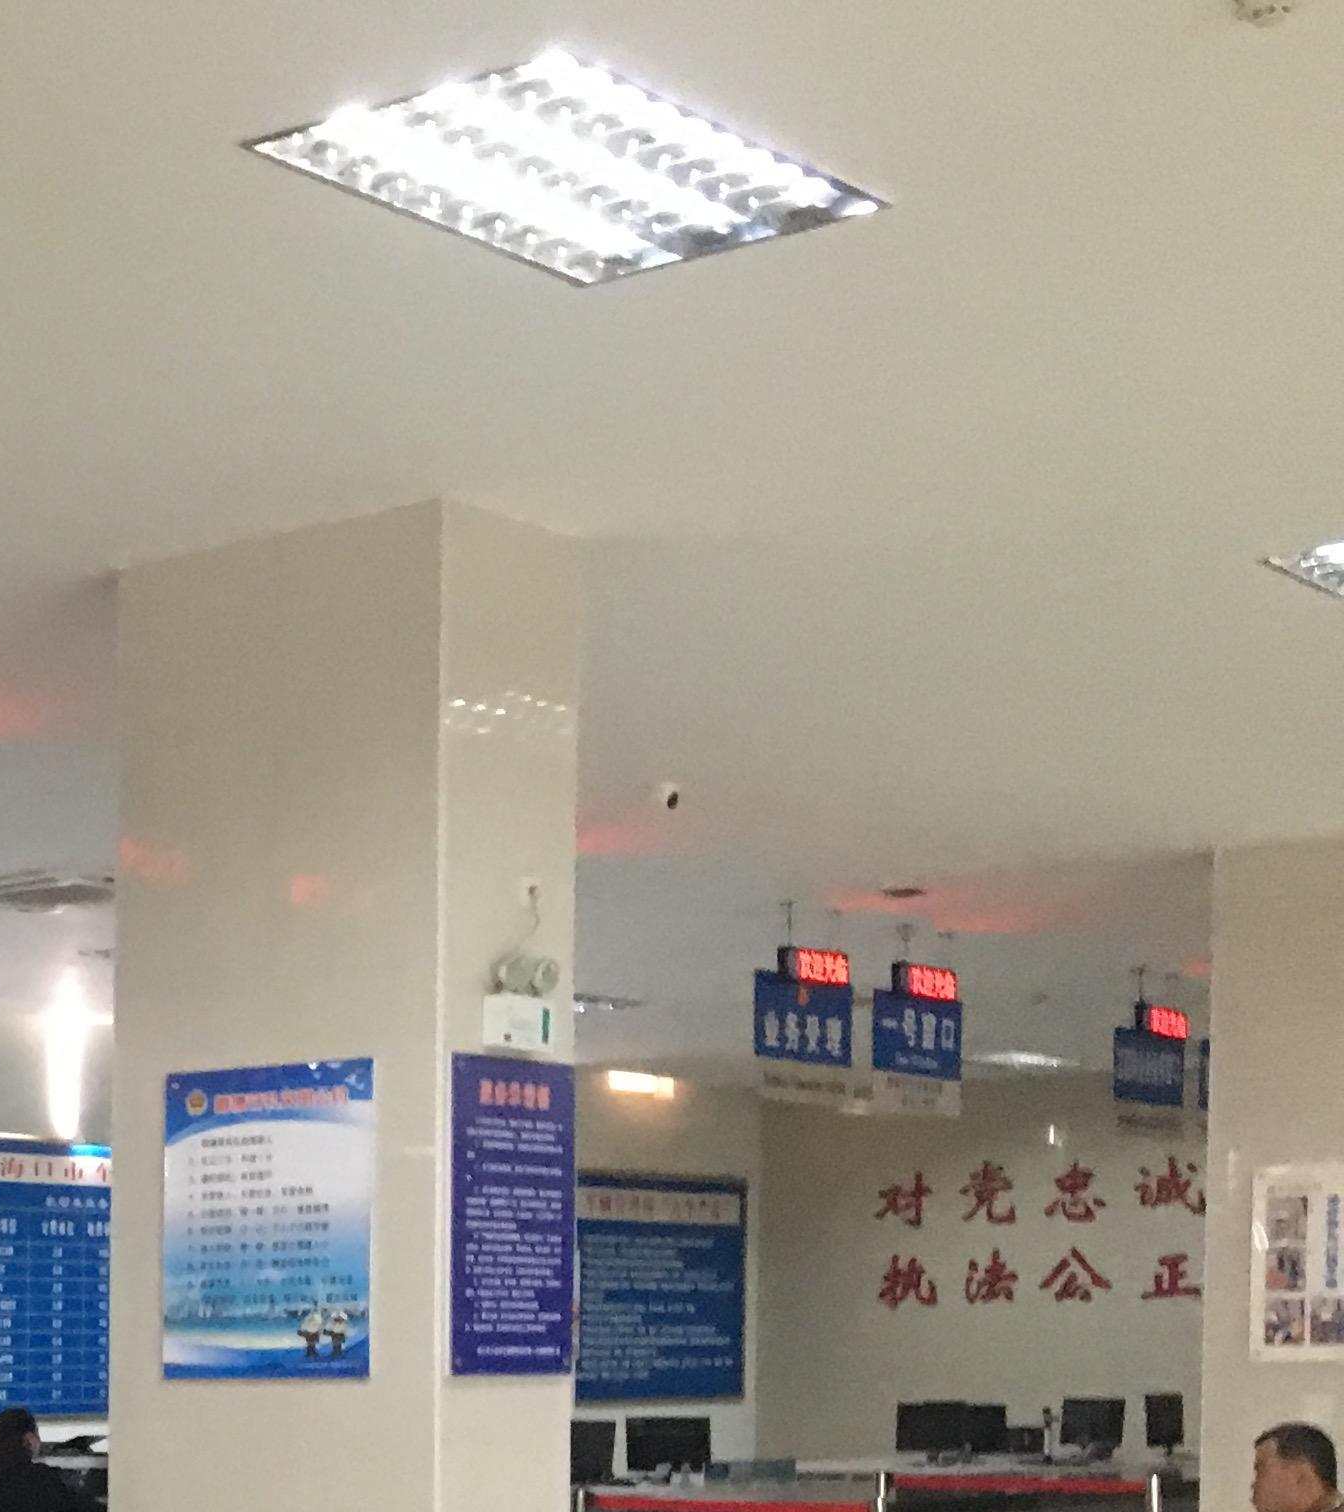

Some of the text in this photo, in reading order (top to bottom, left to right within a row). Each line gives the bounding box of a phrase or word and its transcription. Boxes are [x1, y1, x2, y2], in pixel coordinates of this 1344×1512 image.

[874, 1154, 1207, 1229] 对党忠诚
[877, 1246, 1204, 1311] 执法公正
